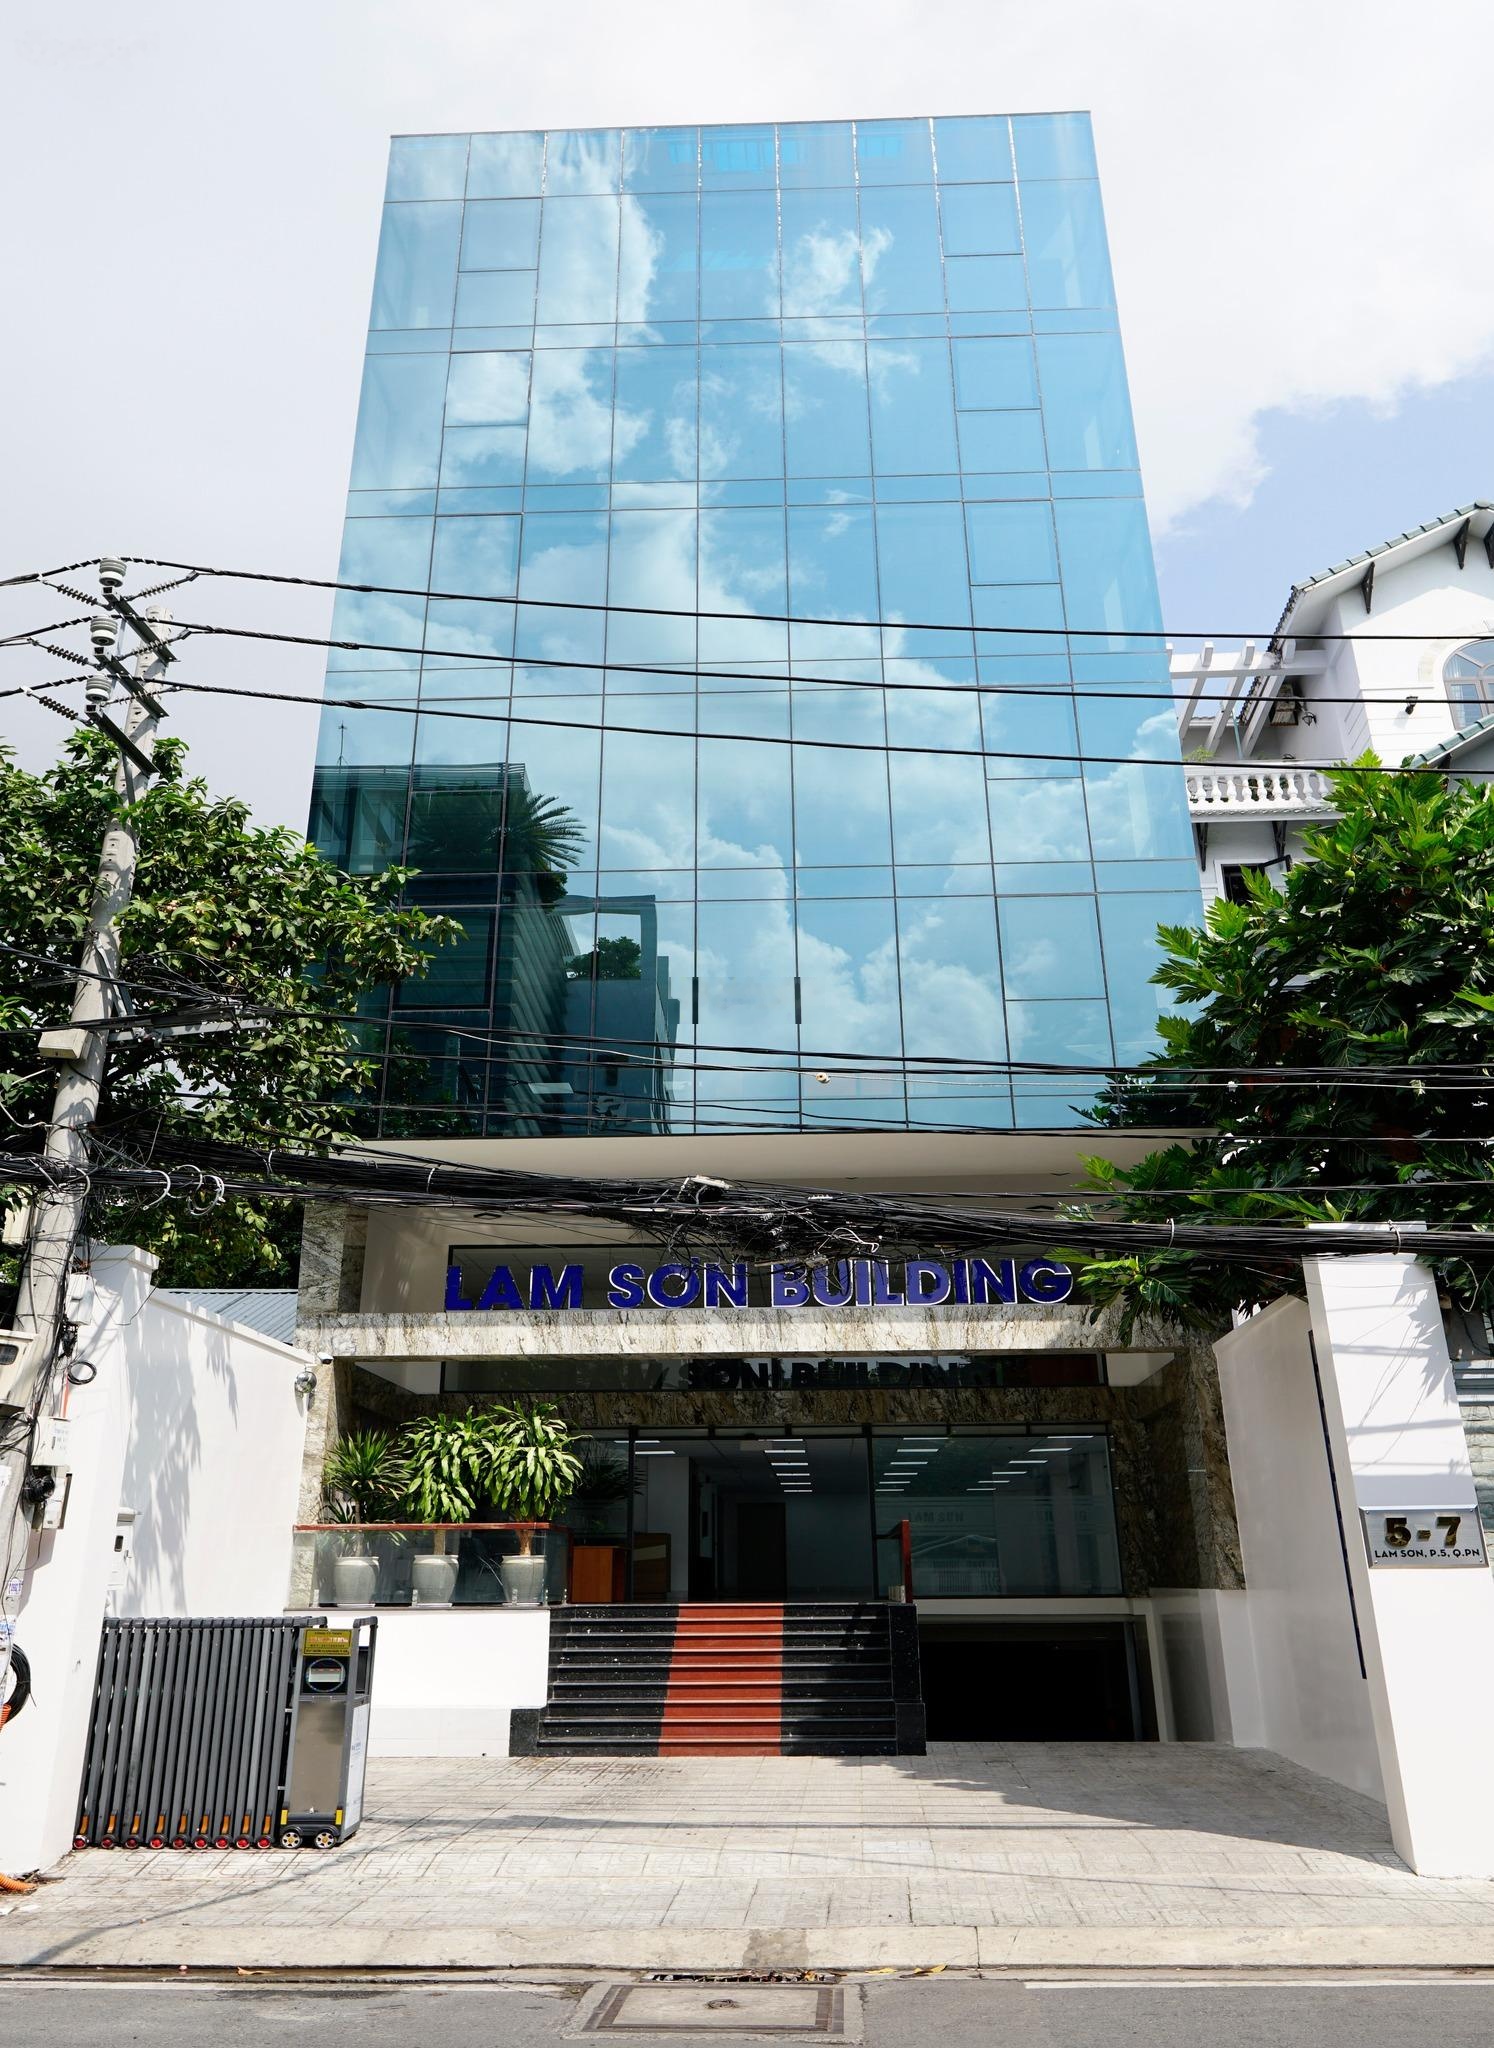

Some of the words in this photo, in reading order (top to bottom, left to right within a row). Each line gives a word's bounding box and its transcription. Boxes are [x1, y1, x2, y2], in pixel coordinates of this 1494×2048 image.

[445, 1264, 584, 1310] LAM
[770, 1258, 1074, 1307] BUILDING
[1374, 1550, 1398, 1558] LAM
[1452, 1549, 1480, 1558] Q.PN
